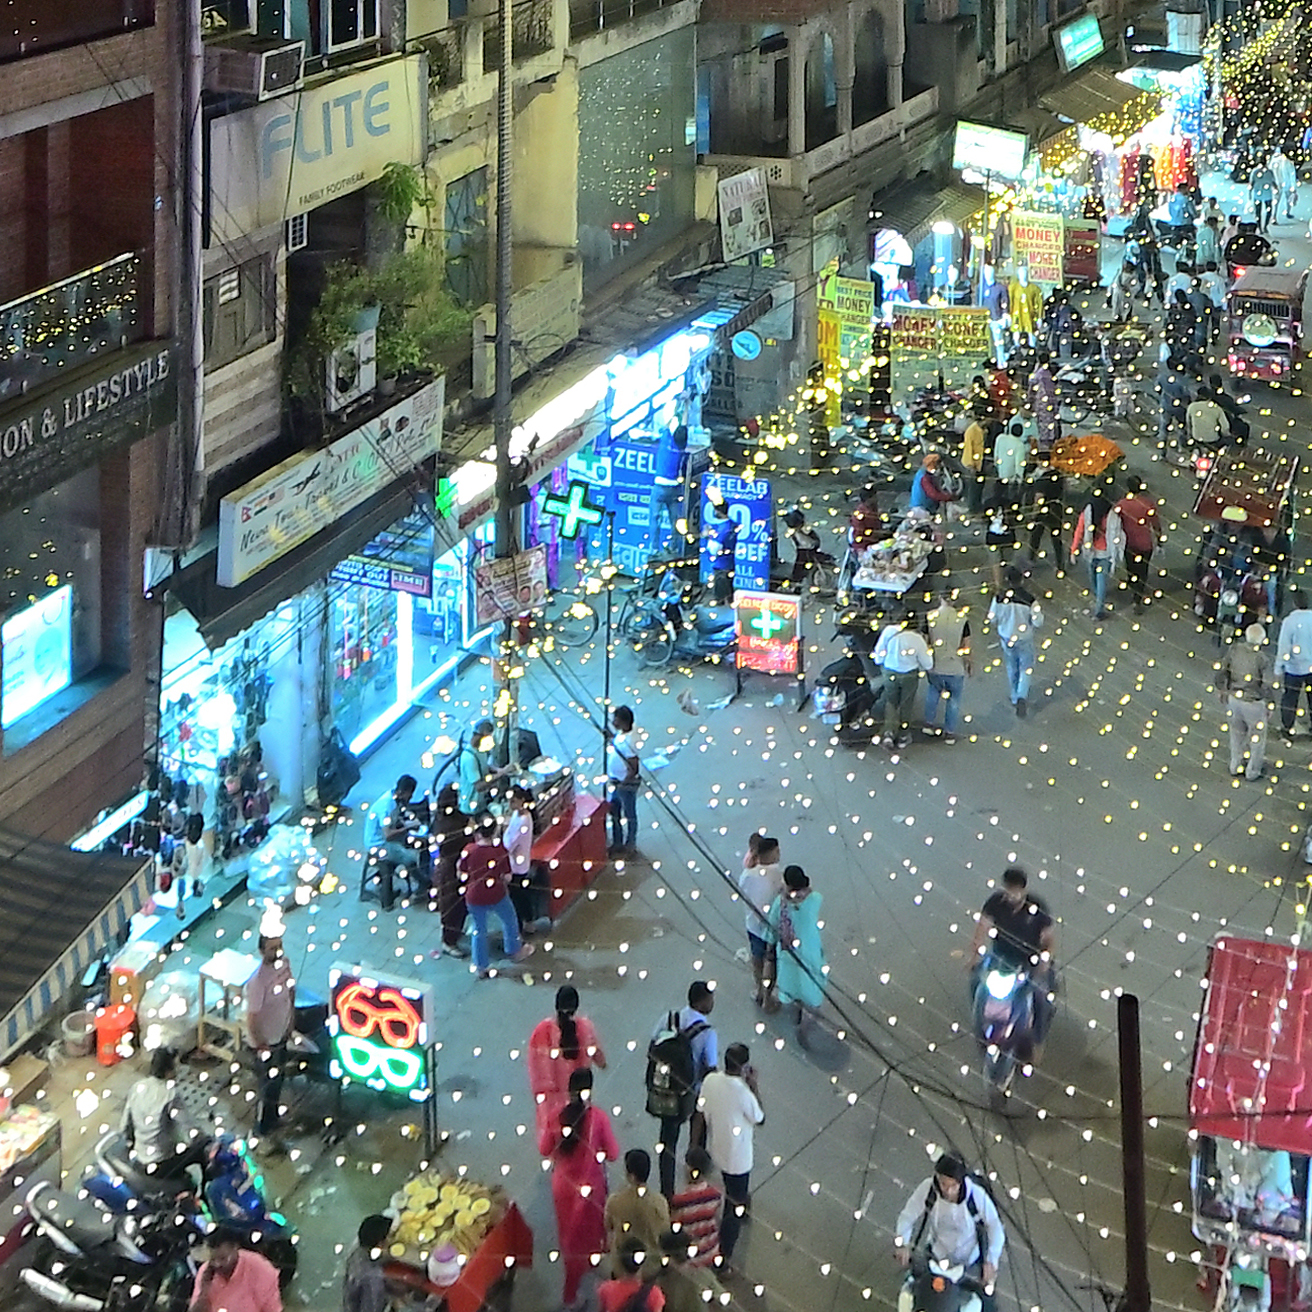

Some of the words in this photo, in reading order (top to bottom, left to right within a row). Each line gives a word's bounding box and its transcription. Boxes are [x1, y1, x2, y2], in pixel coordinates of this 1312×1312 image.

[261, 81, 391, 179] FLITE
[299, 189, 325, 207] FAMILY
[326, 172, 366, 195] FOOTWEAR
[1015, 227, 1060, 243] MONEY
[837, 295, 871, 314] MONEY
[893, 314, 937, 332] MONEY
[943, 320, 987, 335] MONEY
[41, 407, 58, 439] &
[63, 349, 170, 428] LIFESTYLE
[613, 447, 657, 474] ZEEL
[705, 476, 768, 495] ZEELAB
